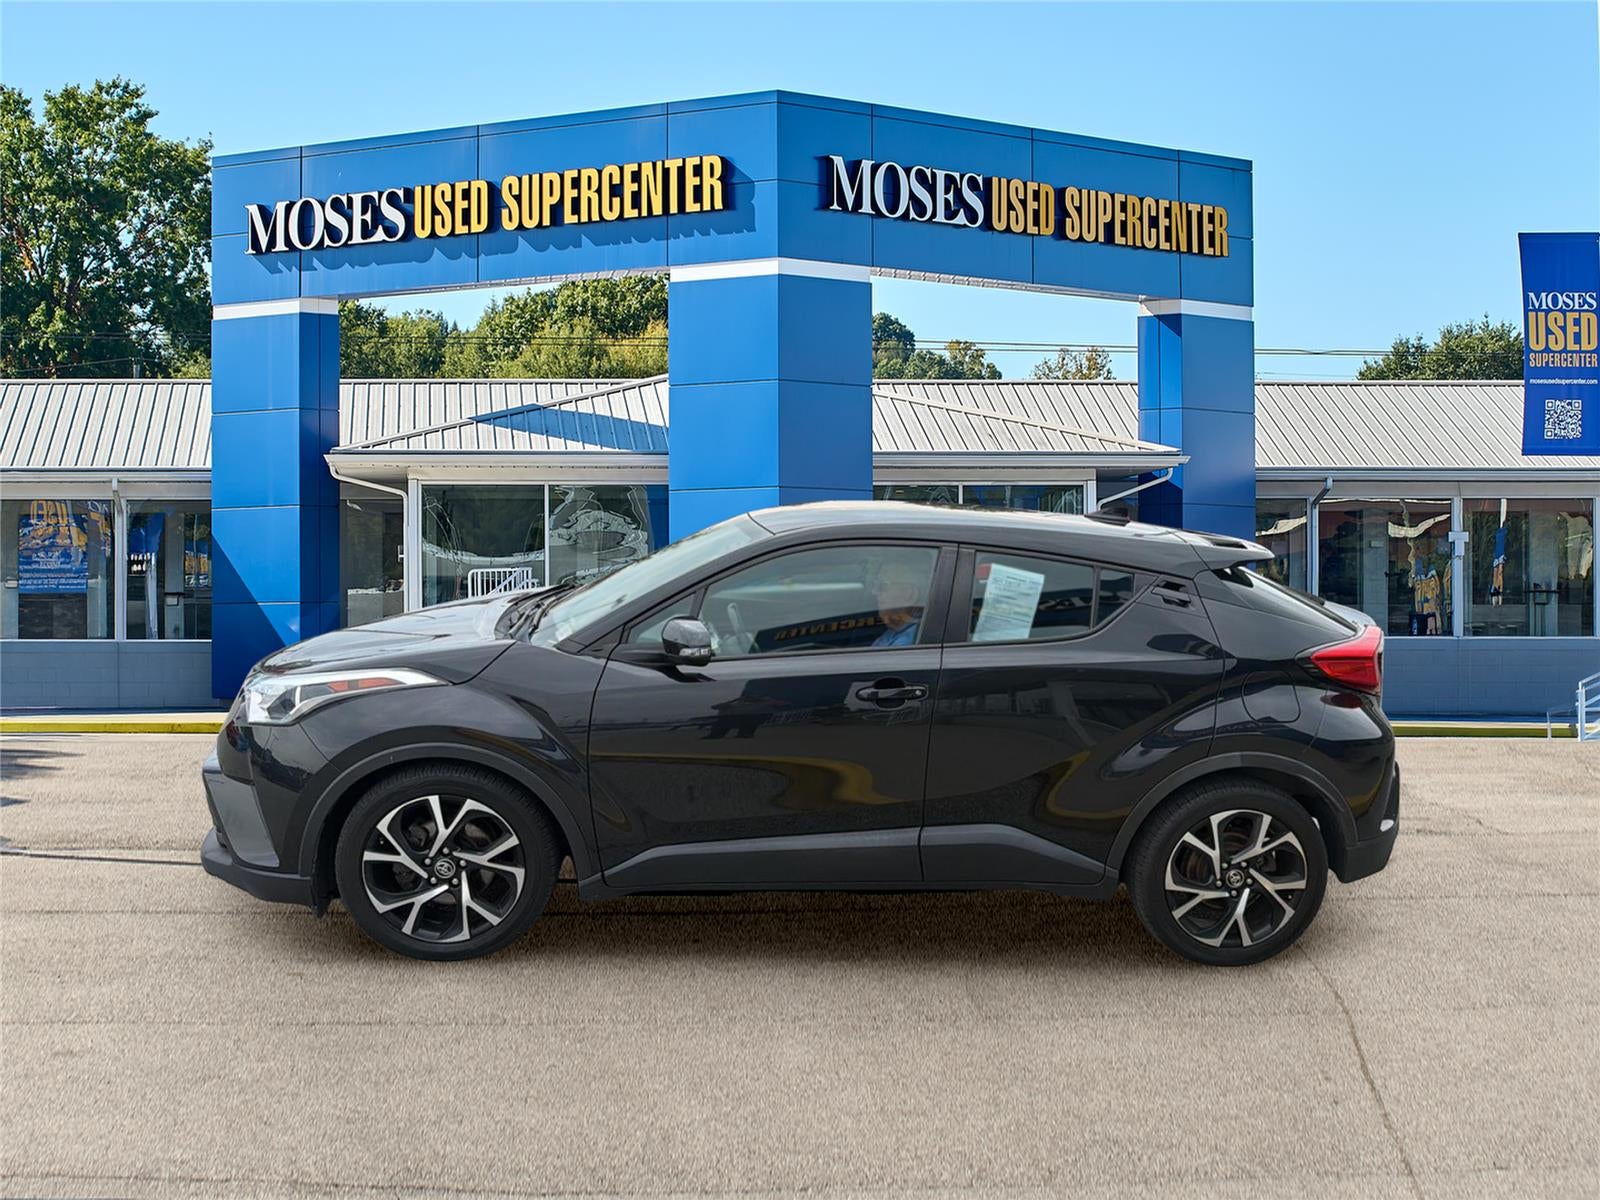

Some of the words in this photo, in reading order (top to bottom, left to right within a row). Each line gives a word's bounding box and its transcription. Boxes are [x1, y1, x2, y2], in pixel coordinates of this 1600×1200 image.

[244, 188, 408, 256] MOSES
[414, 180, 489, 239] USED
[501, 155, 724, 231] SUPERCENTER
[829, 155, 984, 228] MOSES
[991, 175, 1056, 237] USED
[1064, 185, 1230, 258] SUPERCENTER
[1528, 293, 1597, 310] MOSES
[1528, 312, 1598, 351] USED
[1530, 354, 1598, 367] SUPERCENTER
